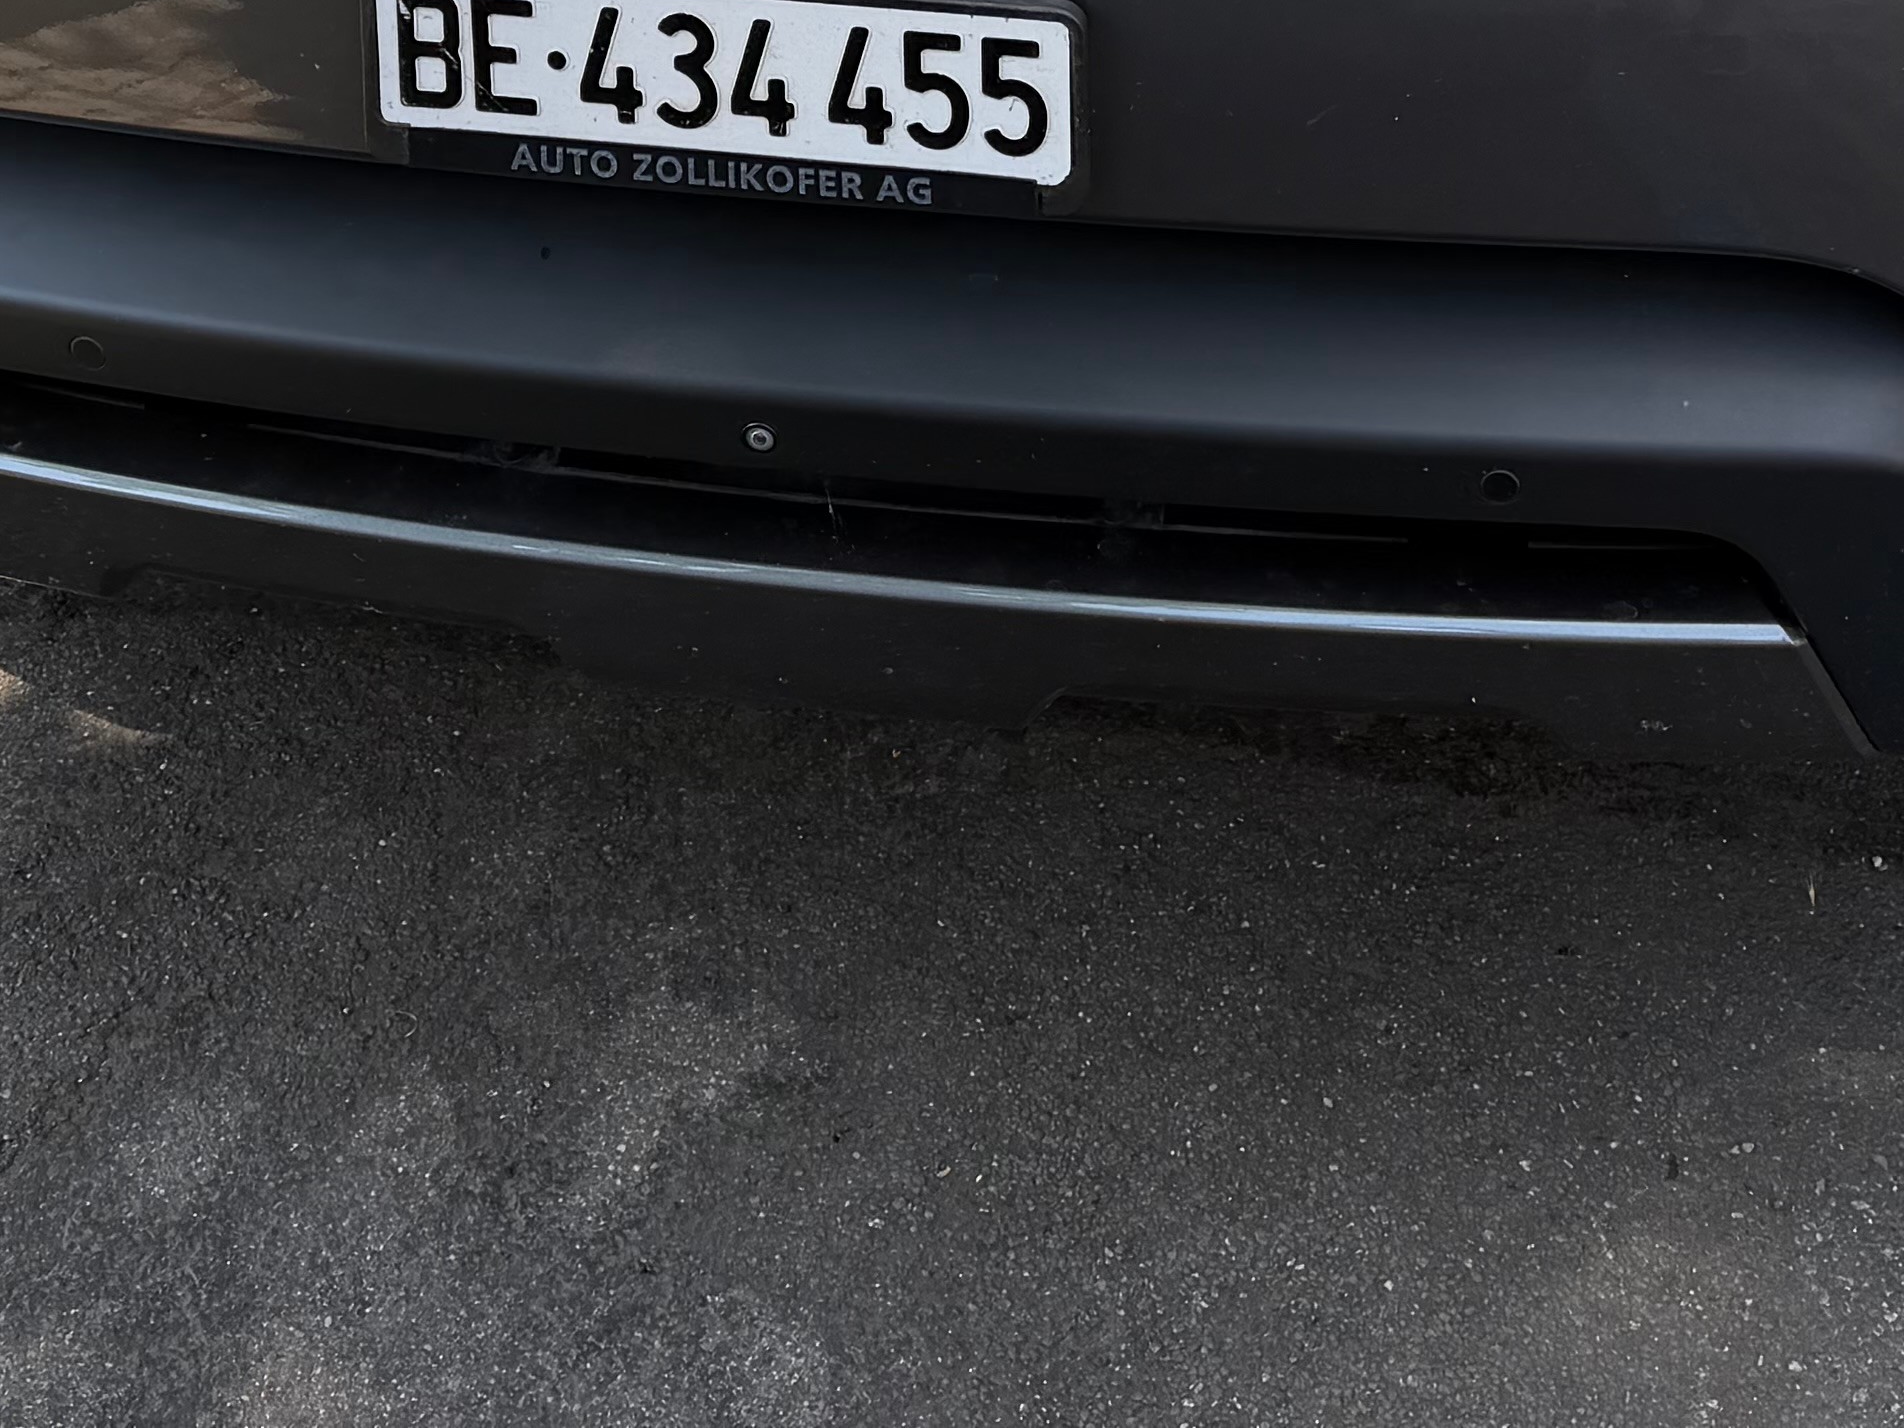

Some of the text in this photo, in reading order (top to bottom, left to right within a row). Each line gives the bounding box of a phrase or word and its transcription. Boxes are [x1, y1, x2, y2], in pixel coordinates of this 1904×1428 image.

[510, 142, 935, 207] AUTO ZOLLIKOFER AG
